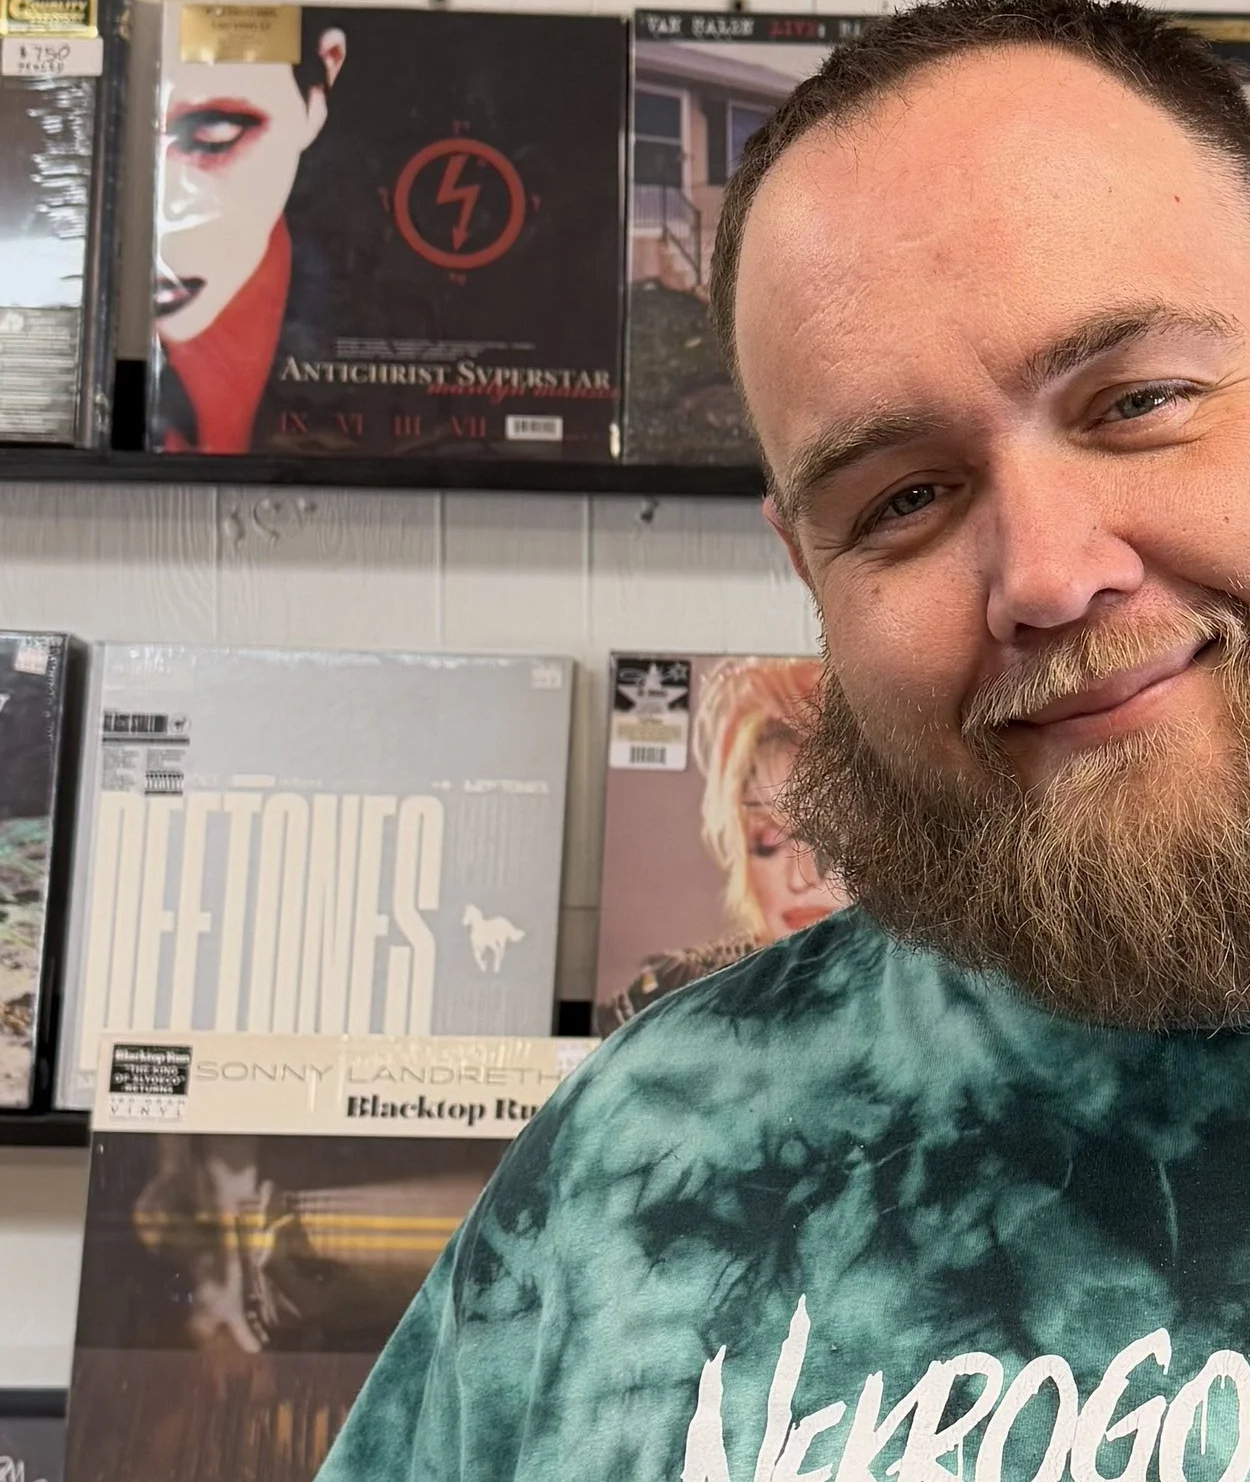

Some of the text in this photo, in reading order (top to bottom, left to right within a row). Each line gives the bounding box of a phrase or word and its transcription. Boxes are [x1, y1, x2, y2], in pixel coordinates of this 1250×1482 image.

[647, 16, 682, 36] VAN
[278, 355, 447, 385] ANTICHRIST
[80, 791, 444, 1070] DEFTONES
[196, 1061, 562, 1086] SONNY LANDRETH
[346, 1094, 487, 1127] Blacktop
